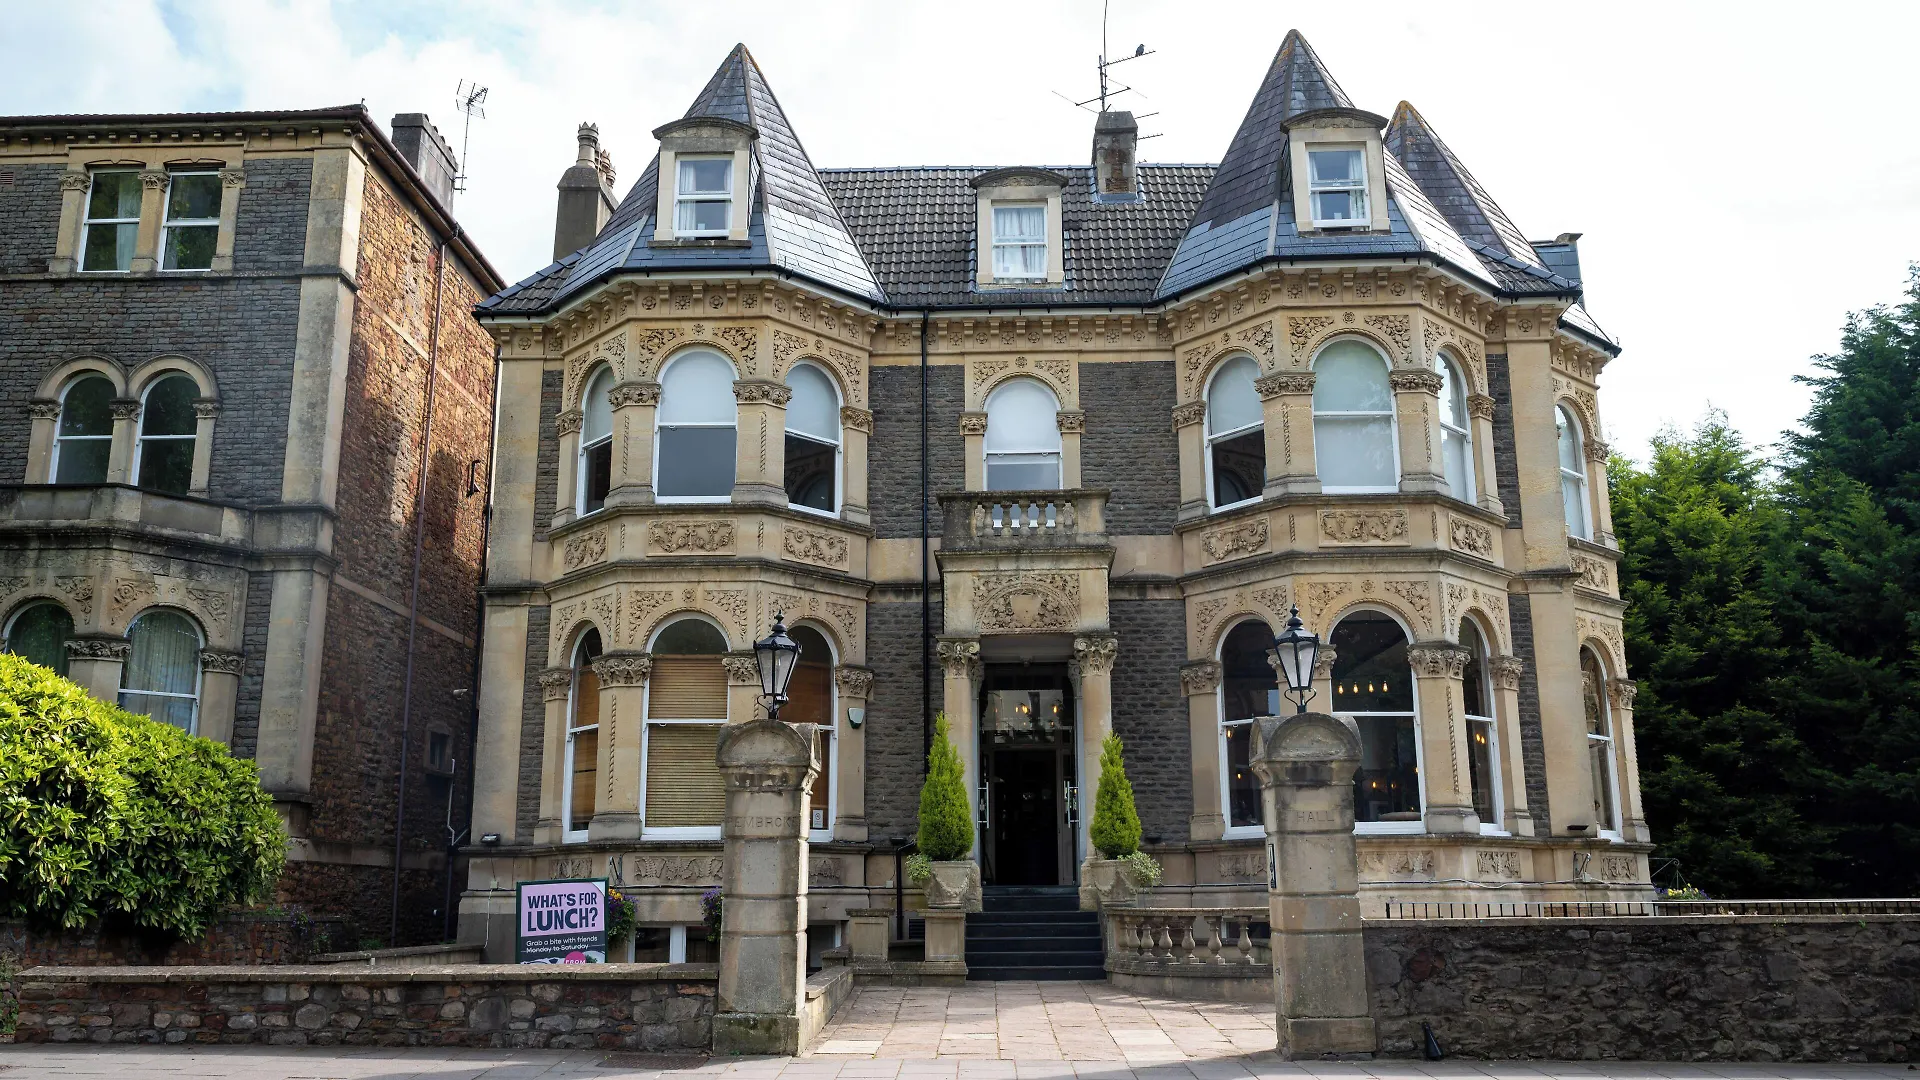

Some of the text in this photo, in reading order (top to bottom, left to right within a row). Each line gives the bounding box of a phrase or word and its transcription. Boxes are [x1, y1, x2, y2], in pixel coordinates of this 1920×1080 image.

[1297, 811, 1334, 822] HALL
[527, 892, 597, 909] WHAT'S FOR
[527, 907, 598, 932] LUNCH?
[549, 937, 562, 945] bite
[562, 936, 576, 944] with
